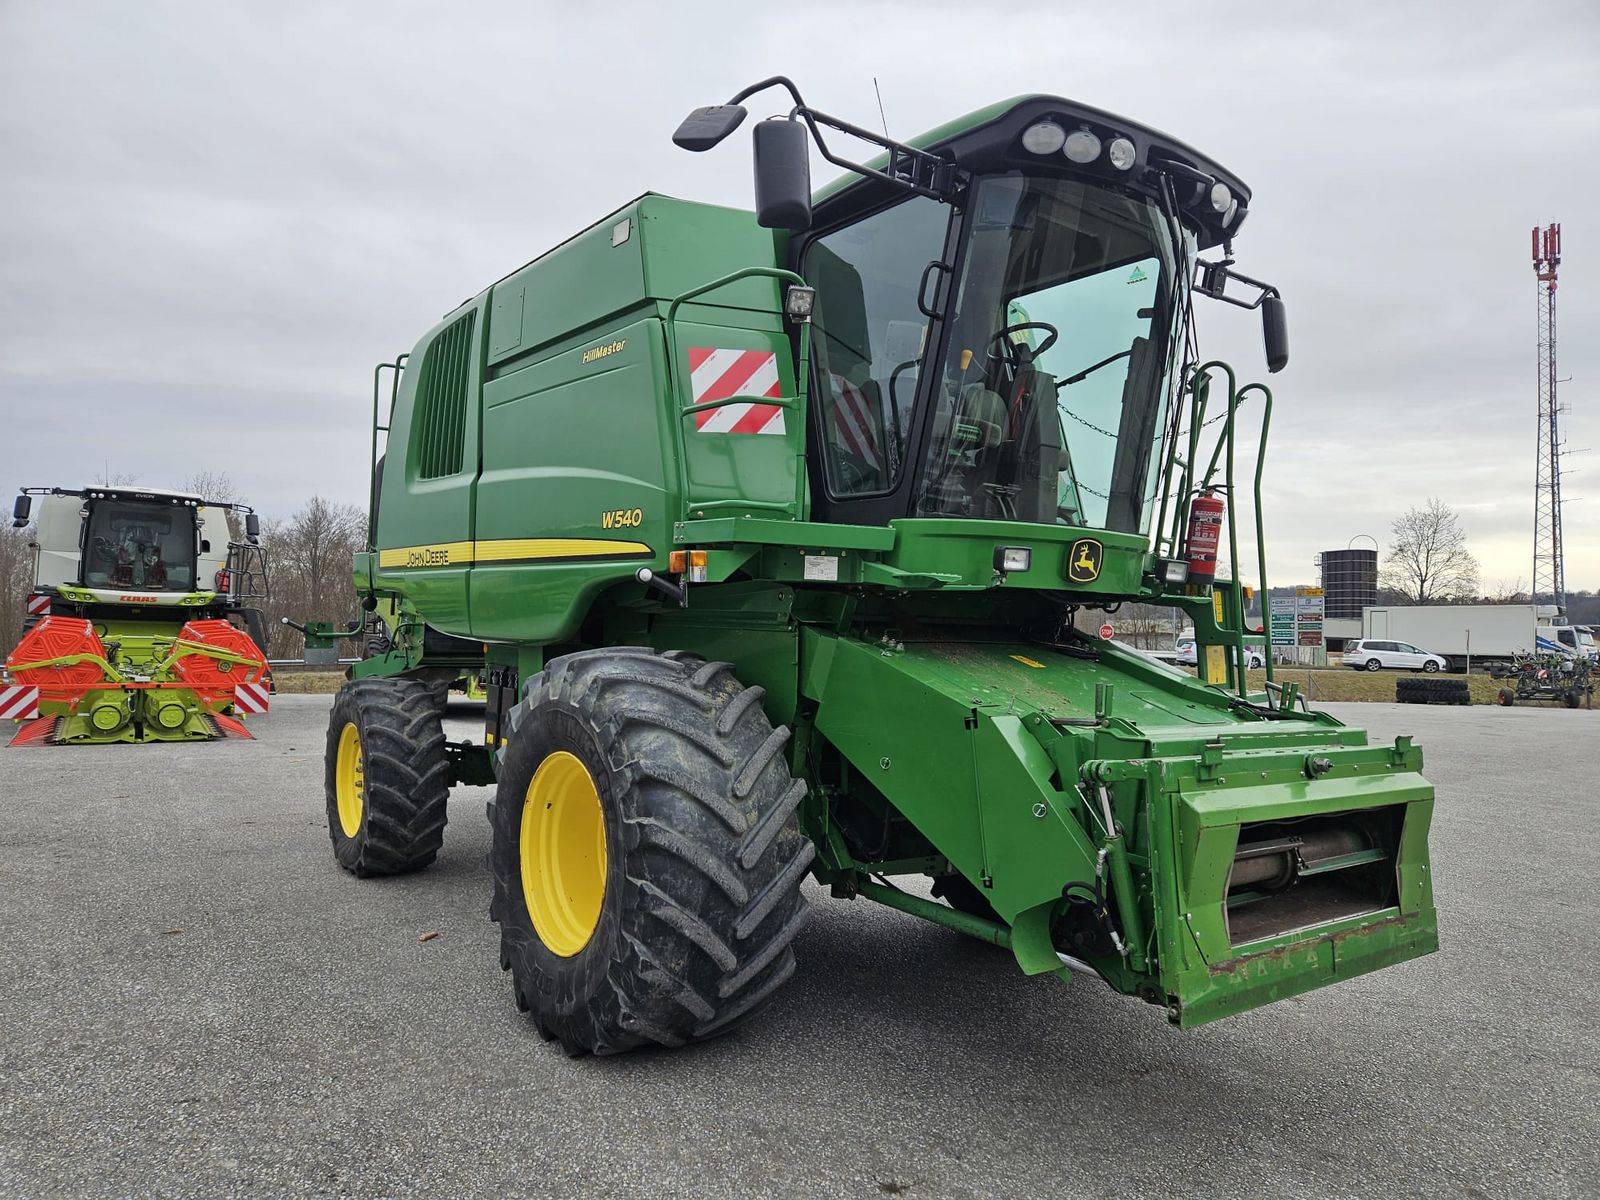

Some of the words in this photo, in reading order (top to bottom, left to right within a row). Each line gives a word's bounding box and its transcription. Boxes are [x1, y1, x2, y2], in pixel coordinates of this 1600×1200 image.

[582, 339, 626, 364] HillMaster
[602, 508, 643, 529] W540
[425, 549, 449, 564] DEERE
[119, 595, 157, 603] CLAAS
